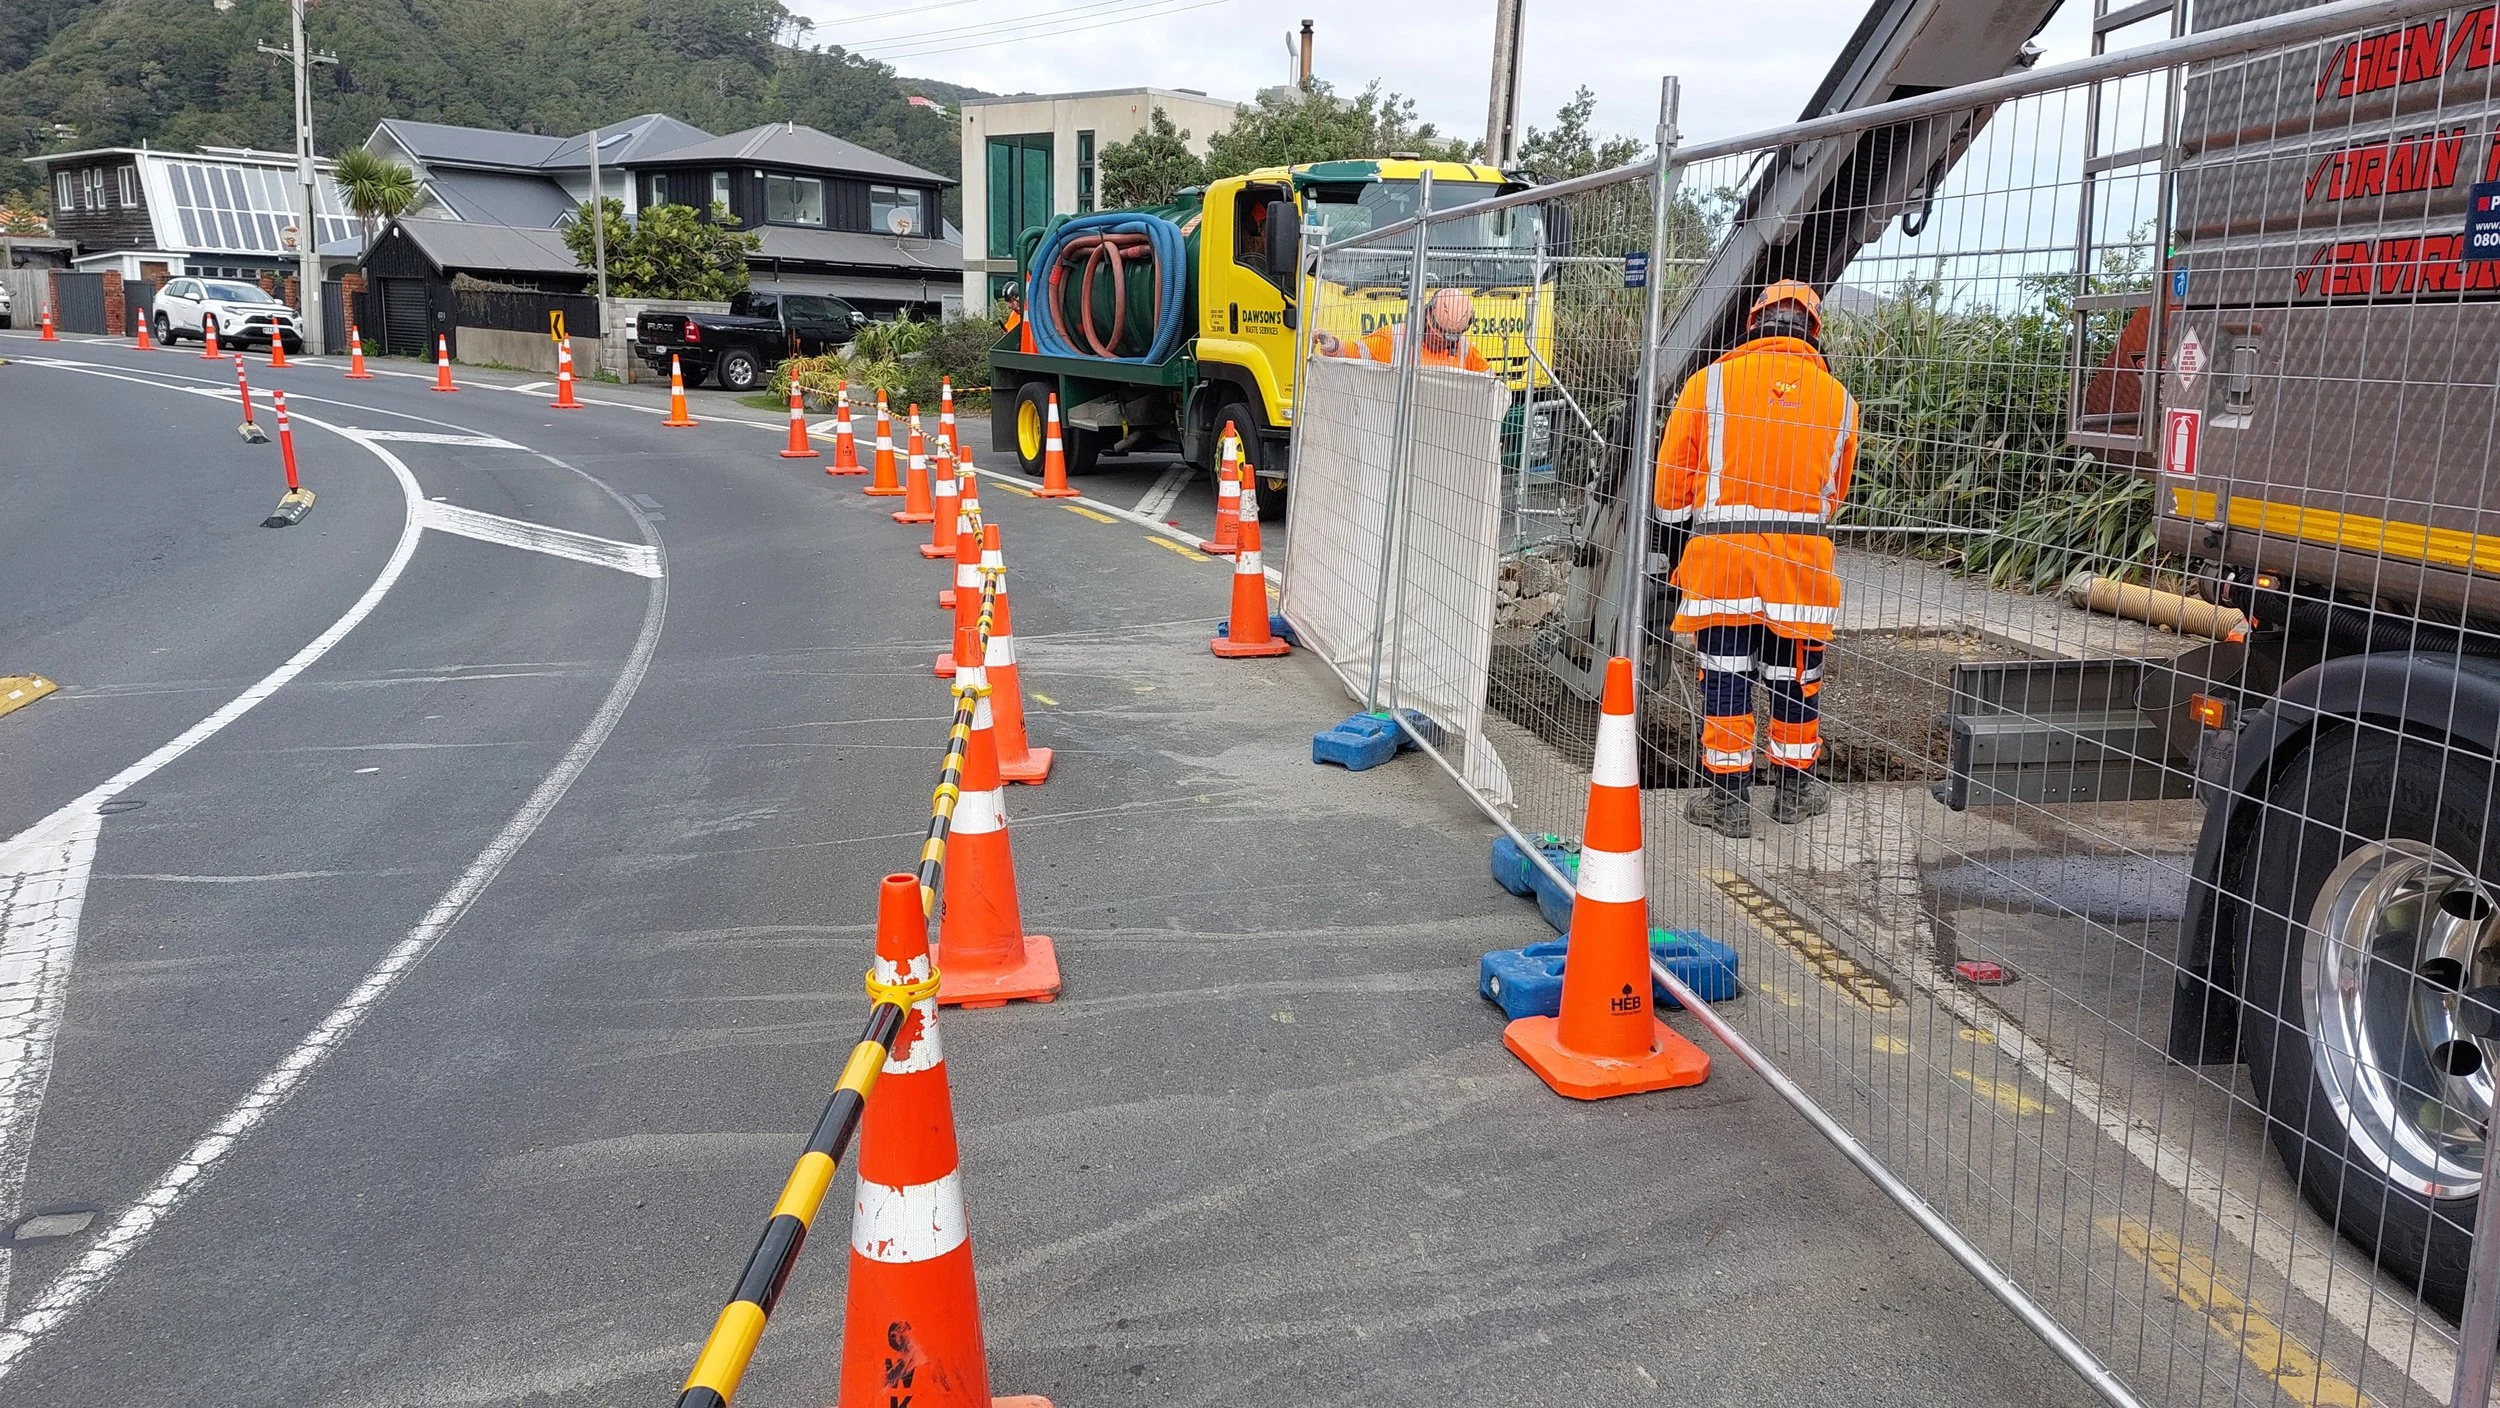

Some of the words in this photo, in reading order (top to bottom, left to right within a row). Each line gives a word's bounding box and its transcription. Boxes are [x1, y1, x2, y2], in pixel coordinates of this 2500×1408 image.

[2327, 127, 2467, 202] DRAIN
[2473, 232, 2500, 247] 080
[1242, 310, 1281, 324] DAWSON'S
[1245, 326, 1259, 334] WASTE
[1259, 326, 1279, 335] SERVICES
[1611, 996, 1641, 1011] HEB
